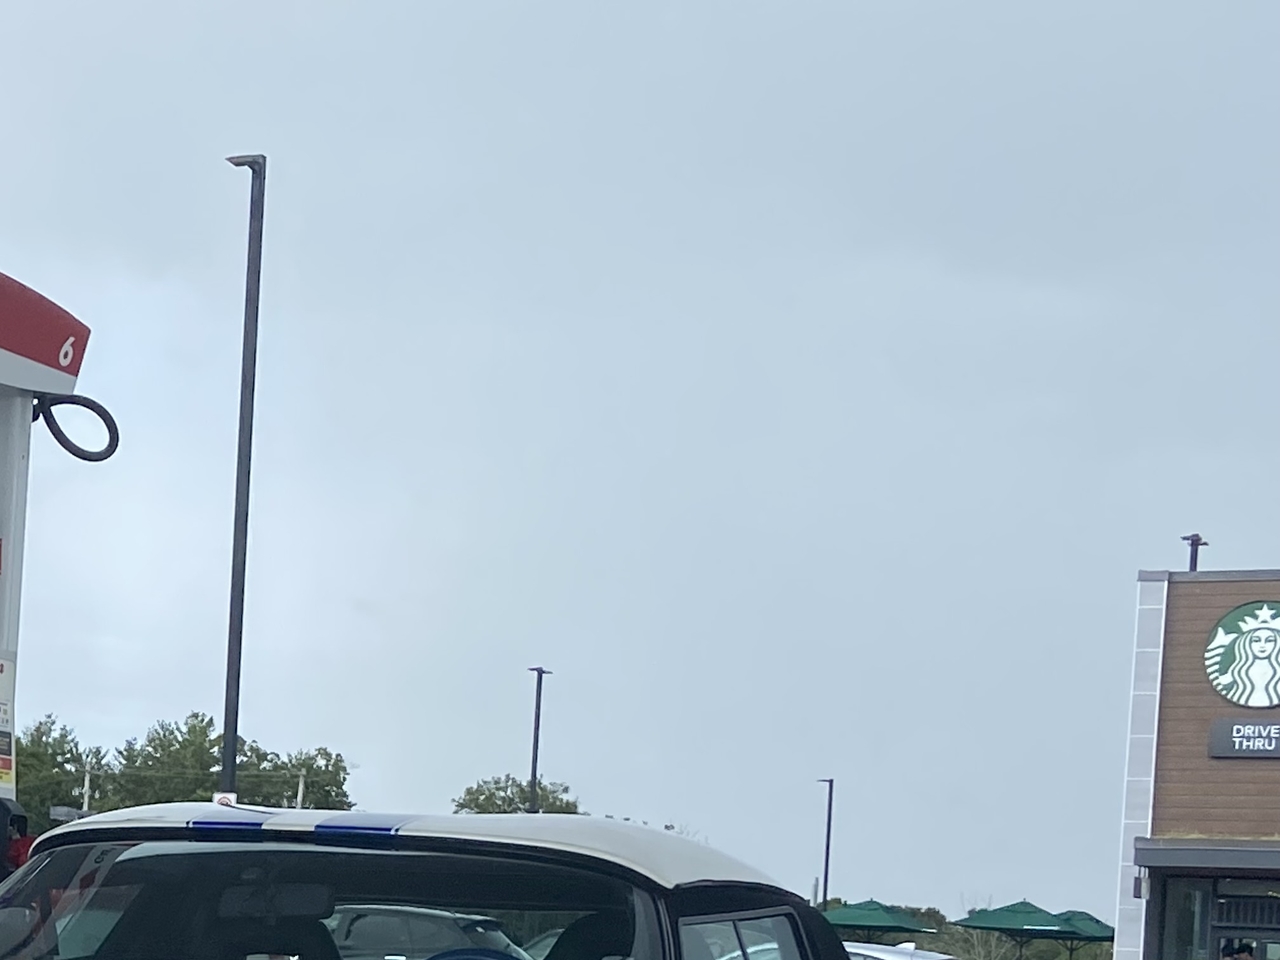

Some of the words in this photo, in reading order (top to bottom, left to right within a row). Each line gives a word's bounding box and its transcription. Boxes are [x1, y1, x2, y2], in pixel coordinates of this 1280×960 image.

[58, 336, 75, 366] 6
[1232, 724, 1280, 737] DRIVE
[1231, 737, 1276, 750] THRU
